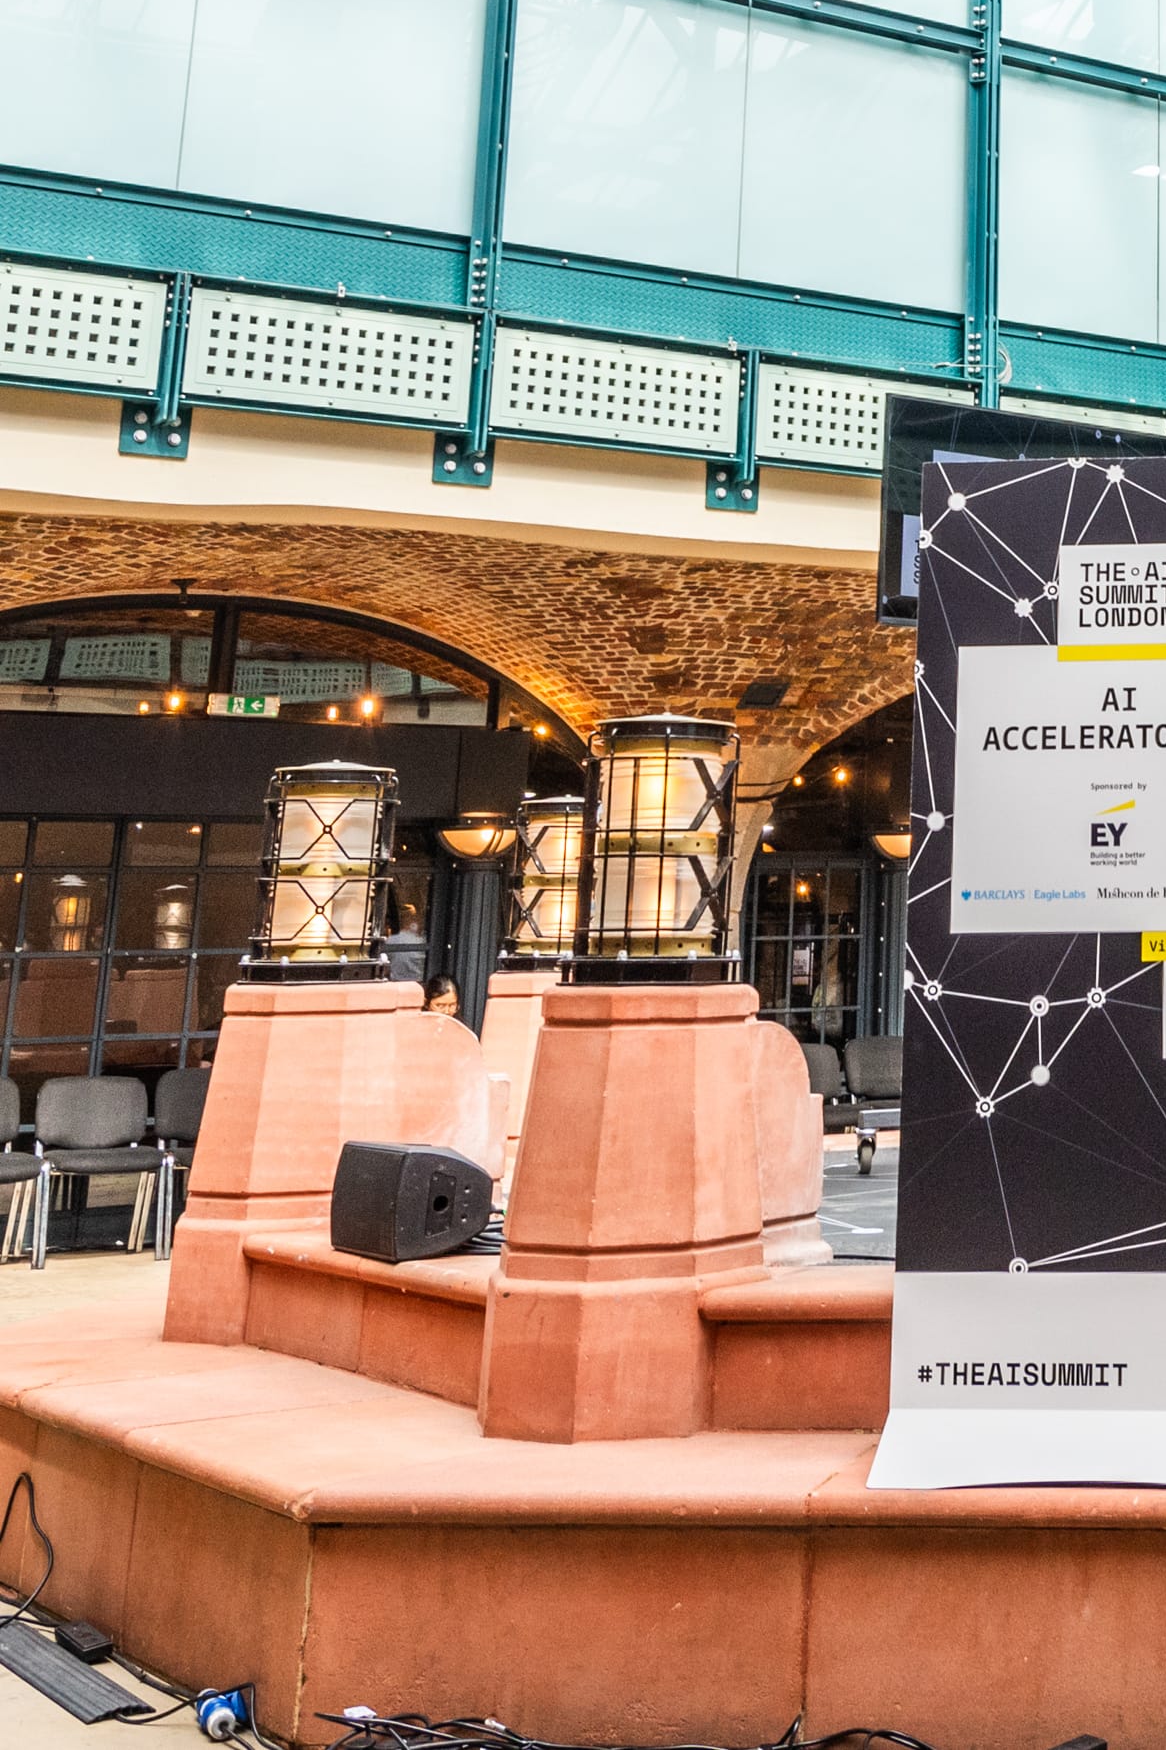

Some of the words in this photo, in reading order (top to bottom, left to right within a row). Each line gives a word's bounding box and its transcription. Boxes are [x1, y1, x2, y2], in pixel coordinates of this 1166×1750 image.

[1080, 562, 1126, 582] THE
[1101, 687, 1137, 712] AI
[1090, 782, 1133, 792] Sponsored
[1137, 782, 1148, 792] by
[1090, 822, 1129, 847] EY
[1090, 851, 1118, 860] Building
[1125, 851, 1146, 859] better
[1090, 859, 1118, 868] working
[974, 889, 1026, 900] BARCLAYS
[1034, 889, 1061, 901] Eagle
[1062, 889, 1087, 899] Labs
[1147, 887, 1160, 899] de
[917, 1362, 1128, 1387] #THEAISUMMIT
